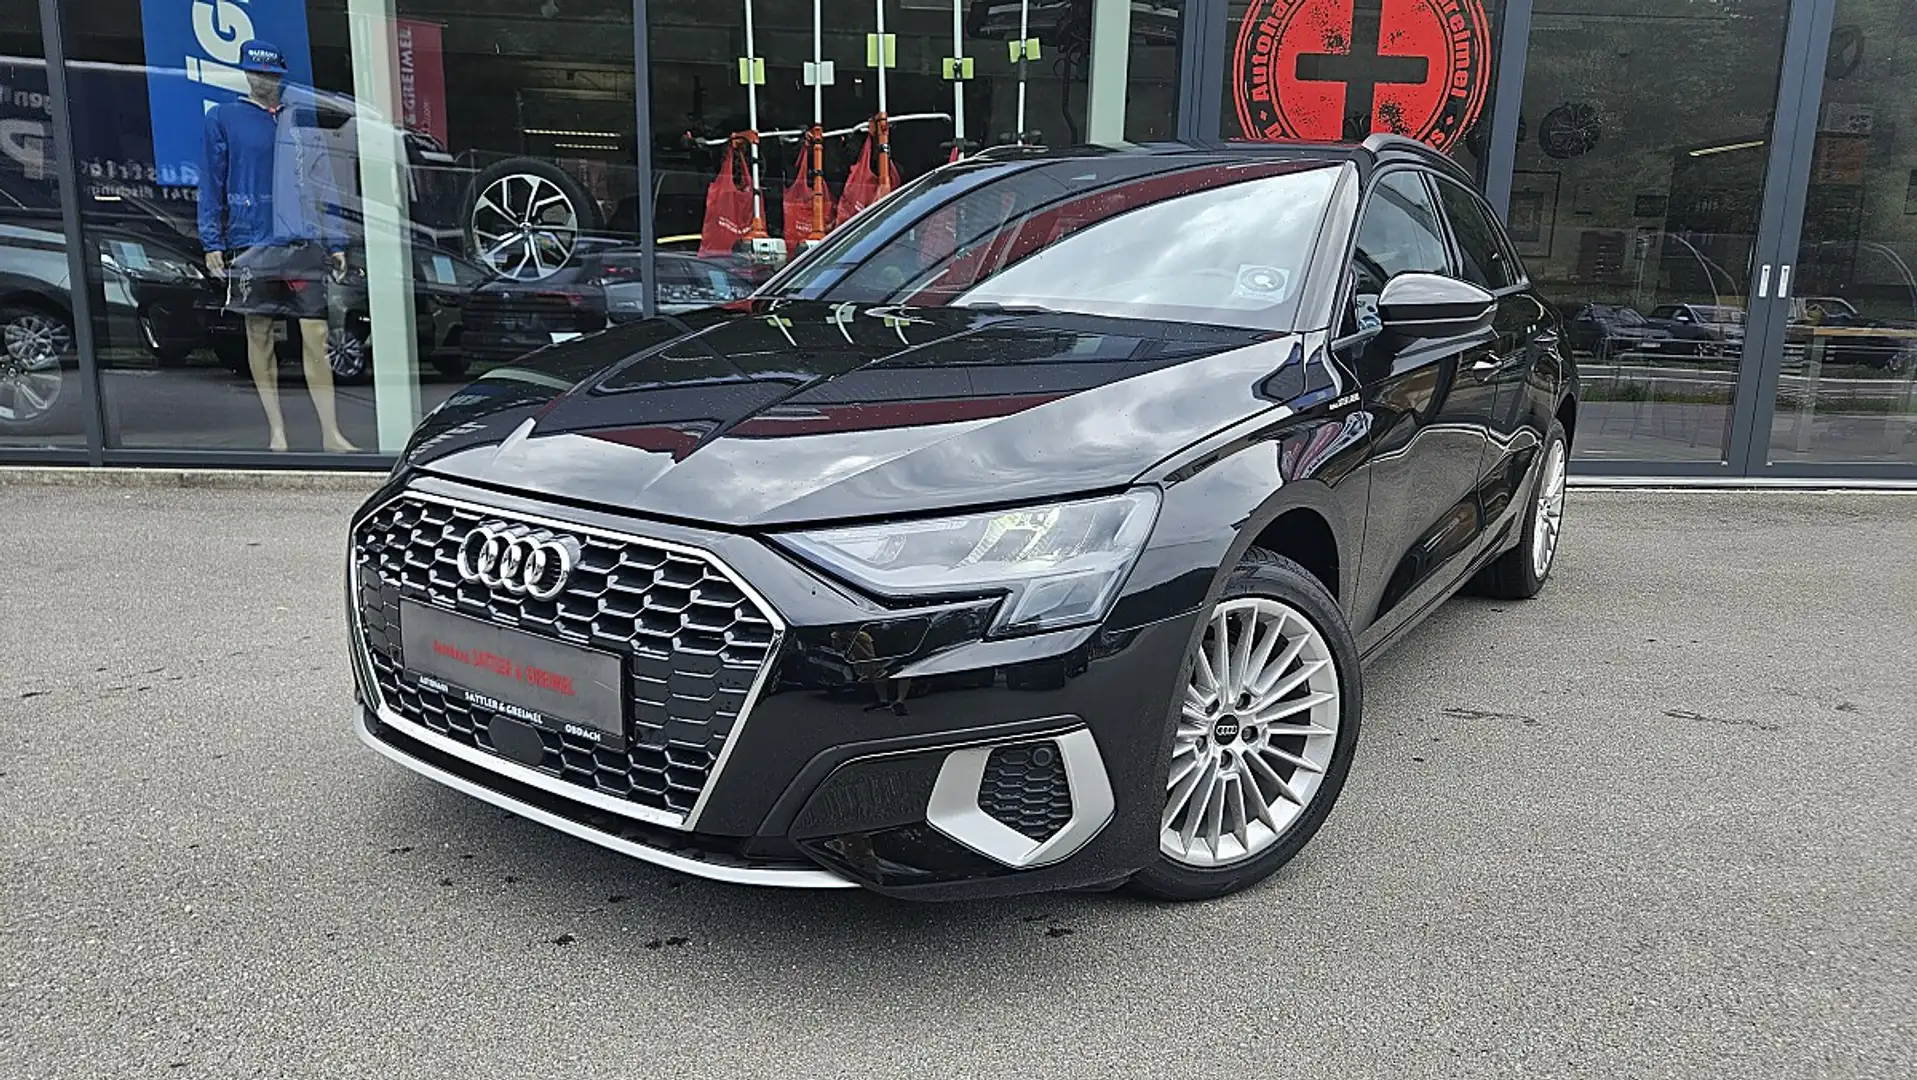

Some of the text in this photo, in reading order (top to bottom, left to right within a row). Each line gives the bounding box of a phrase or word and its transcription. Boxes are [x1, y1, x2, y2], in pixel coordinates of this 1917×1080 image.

[1251, 0, 1471, 102] Autoha reimel
[465, 691, 498, 711] SATTLER
[499, 702, 506, 713] &
[506, 704, 543, 725] GREIMEL
